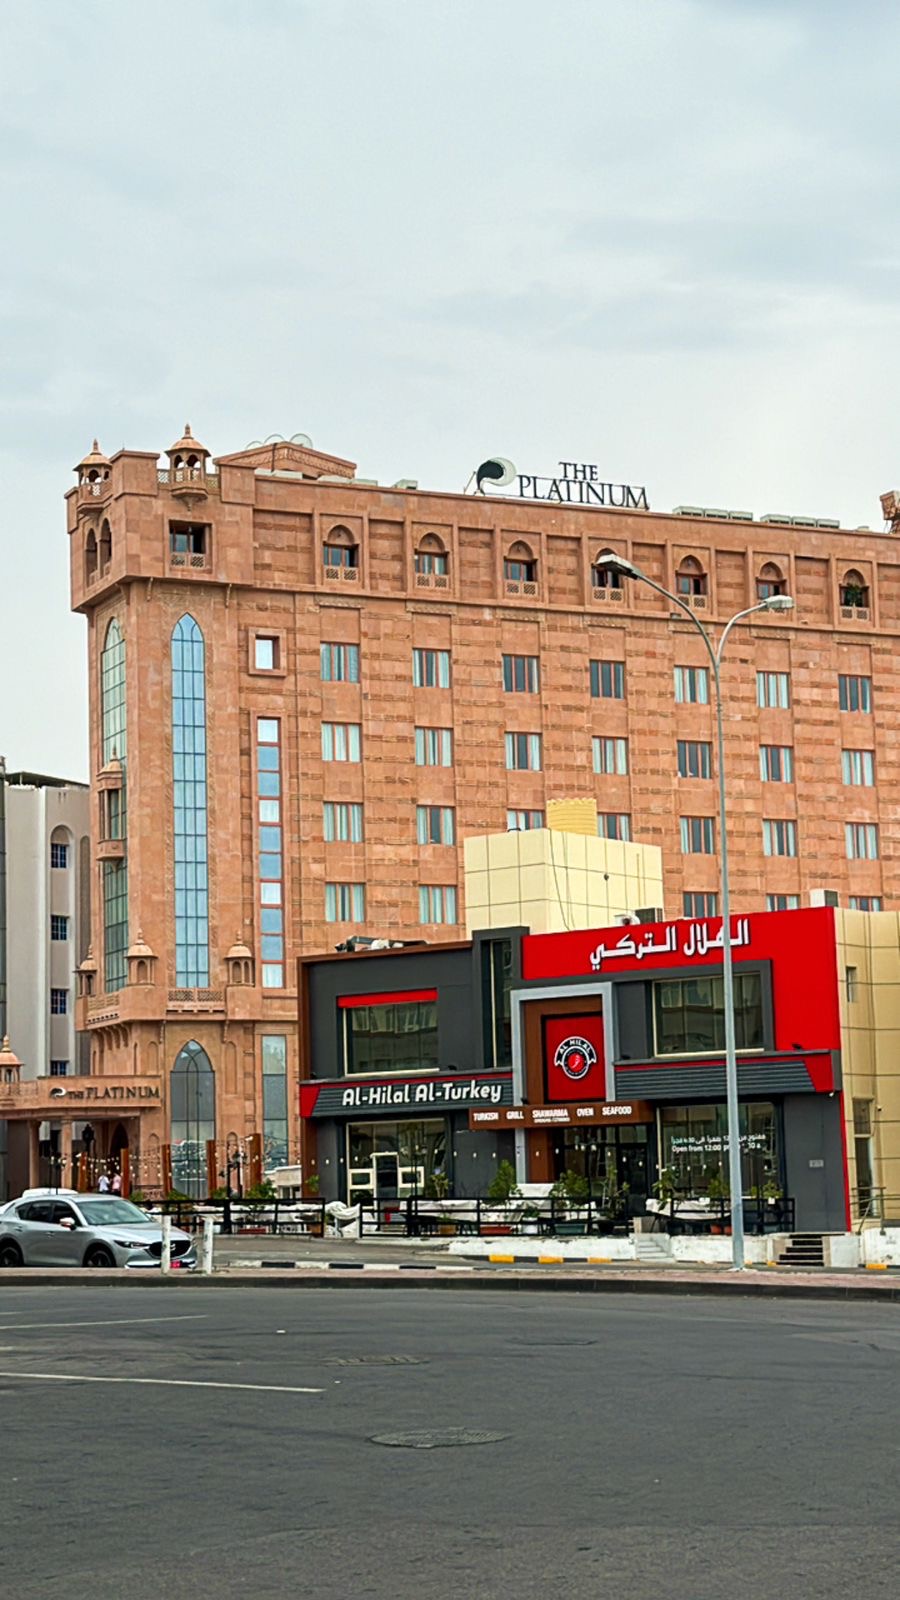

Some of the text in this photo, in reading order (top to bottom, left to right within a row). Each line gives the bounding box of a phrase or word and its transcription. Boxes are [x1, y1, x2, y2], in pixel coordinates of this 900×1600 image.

[559, 461, 598, 481] THE
[517, 474, 650, 511] PLATINUM
[589, 925, 677, 971] التركي
[569, 1039, 592, 1054] HILAL
[68, 1087, 160, 1100] THE PLATINUM
[342, 1080, 502, 1106] Al-Hilal Al-Turkey
[473, 1105, 633, 1122] TURKISH GRILL SHAWARMA OVEN SEAFOOD
[672, 1145, 688, 1154] Open
